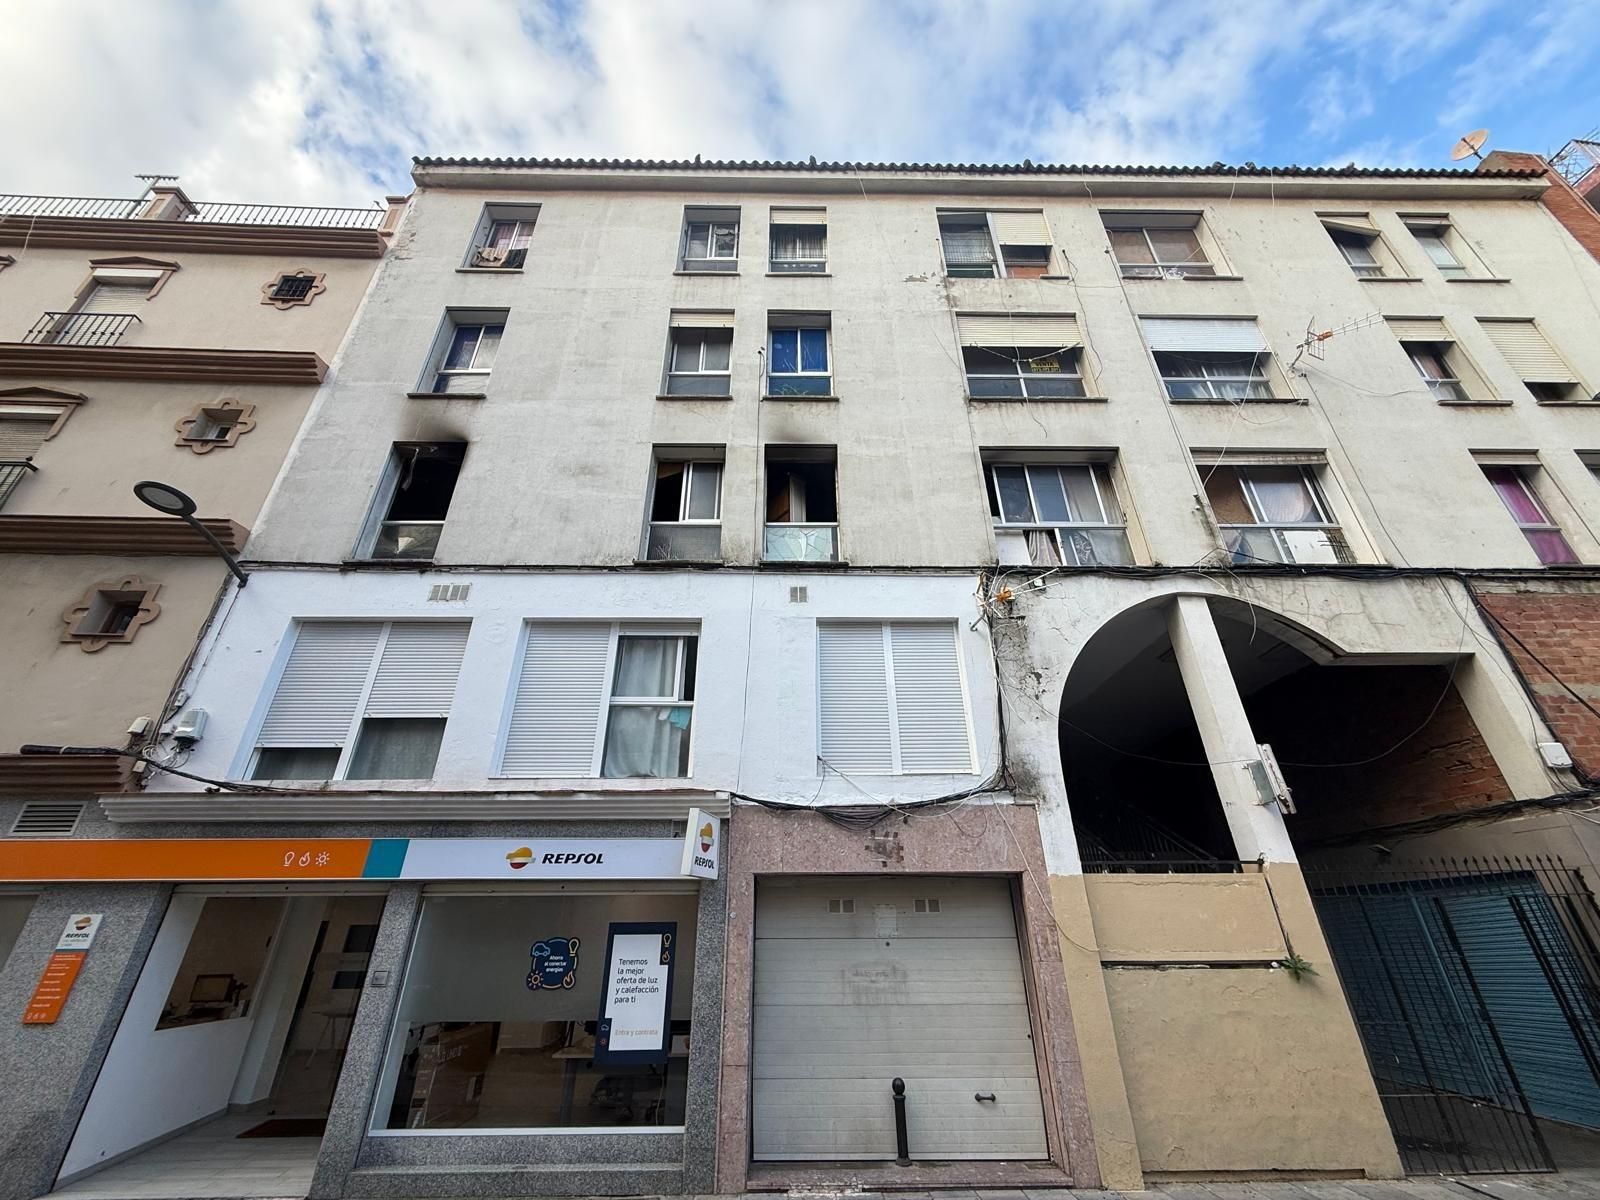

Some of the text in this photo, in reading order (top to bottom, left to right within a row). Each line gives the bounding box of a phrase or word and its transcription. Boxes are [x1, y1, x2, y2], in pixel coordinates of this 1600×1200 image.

[542, 853, 604, 865] REPSOL
[694, 856, 715, 870] REPSOL
[619, 958, 648, 966] Tenemos
[625, 968, 644, 976] mejor
[616, 976, 637, 984] oferta
[648, 976, 659, 984] luz
[615, 985, 659, 995] y calefacción
[614, 995, 636, 1004] para ti
